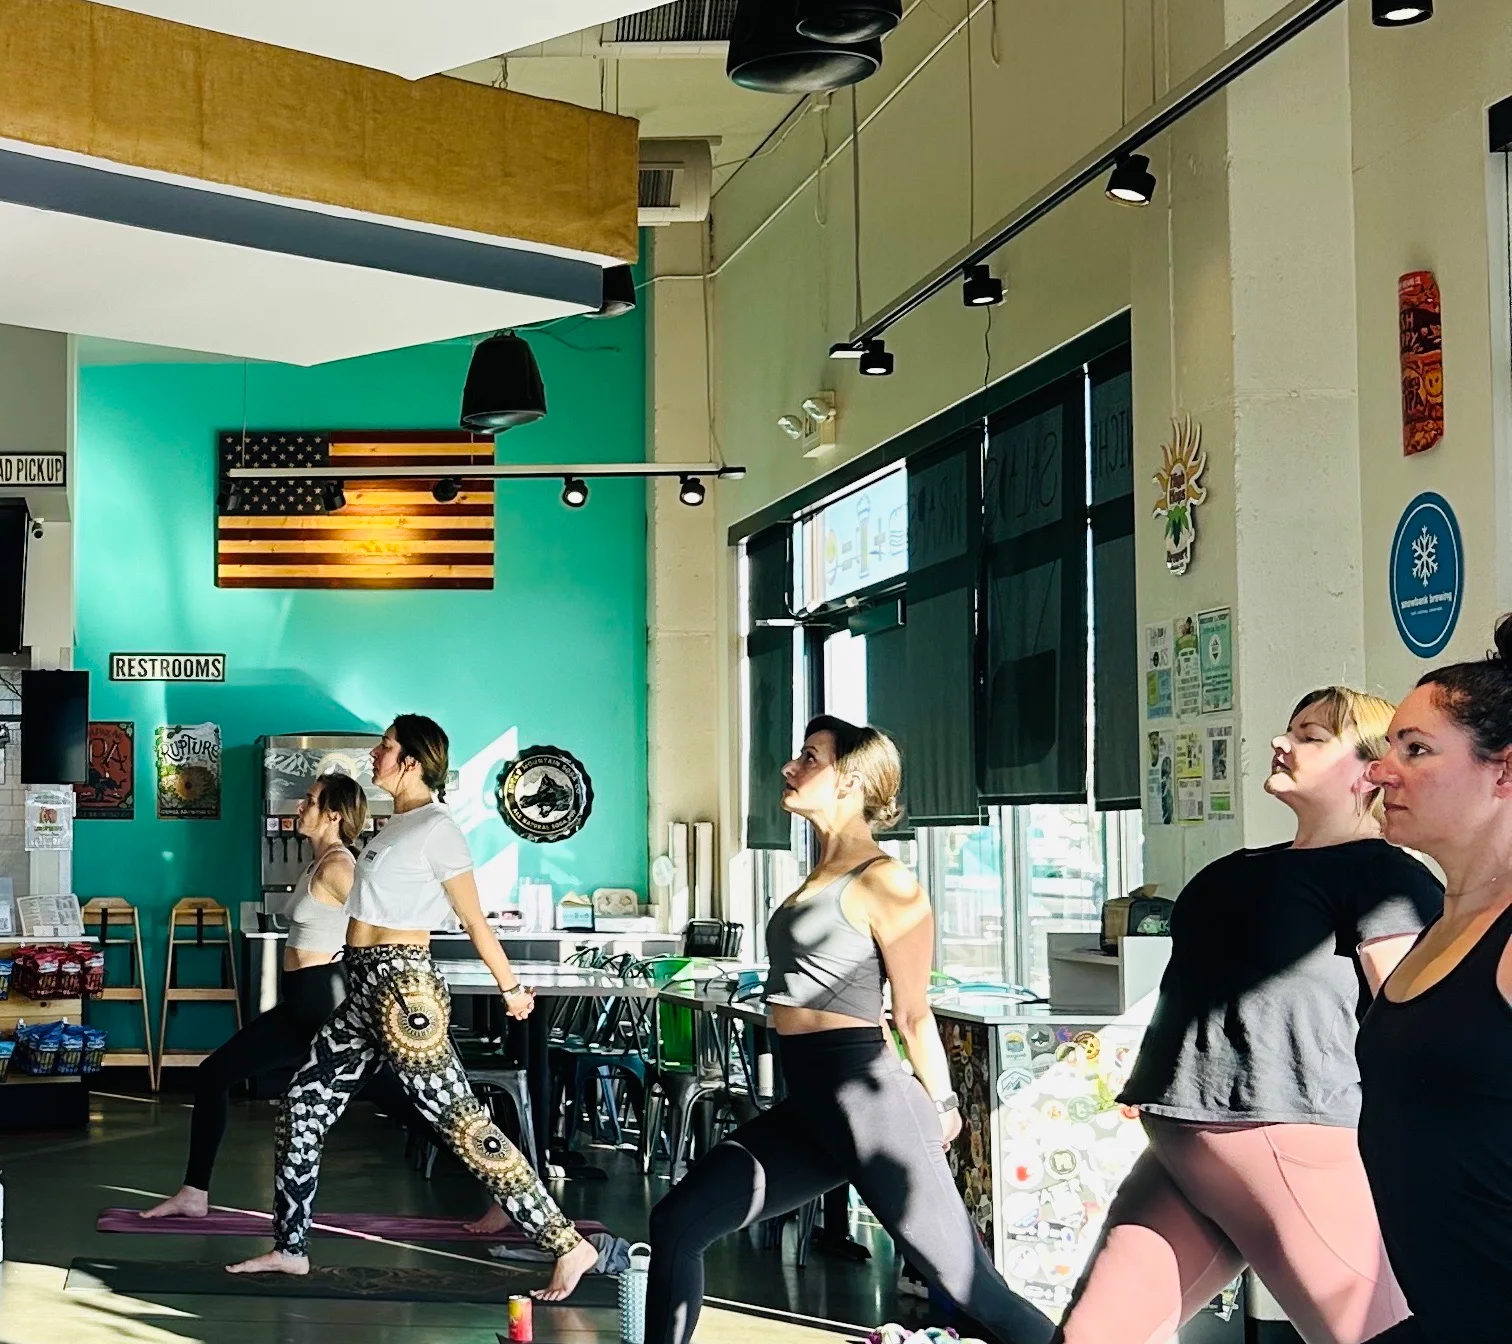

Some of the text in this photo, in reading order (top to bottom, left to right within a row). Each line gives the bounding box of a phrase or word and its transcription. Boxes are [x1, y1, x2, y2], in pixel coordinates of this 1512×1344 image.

[16, 458, 62, 482] PICKUP
[115, 657, 221, 678] RESTROOMS
[160, 733, 220, 763] RUPTURE
[521, 757, 561, 771] MOUNTAIN
[561, 763, 579, 782] SODA
[521, 817, 550, 831] NATURAL
